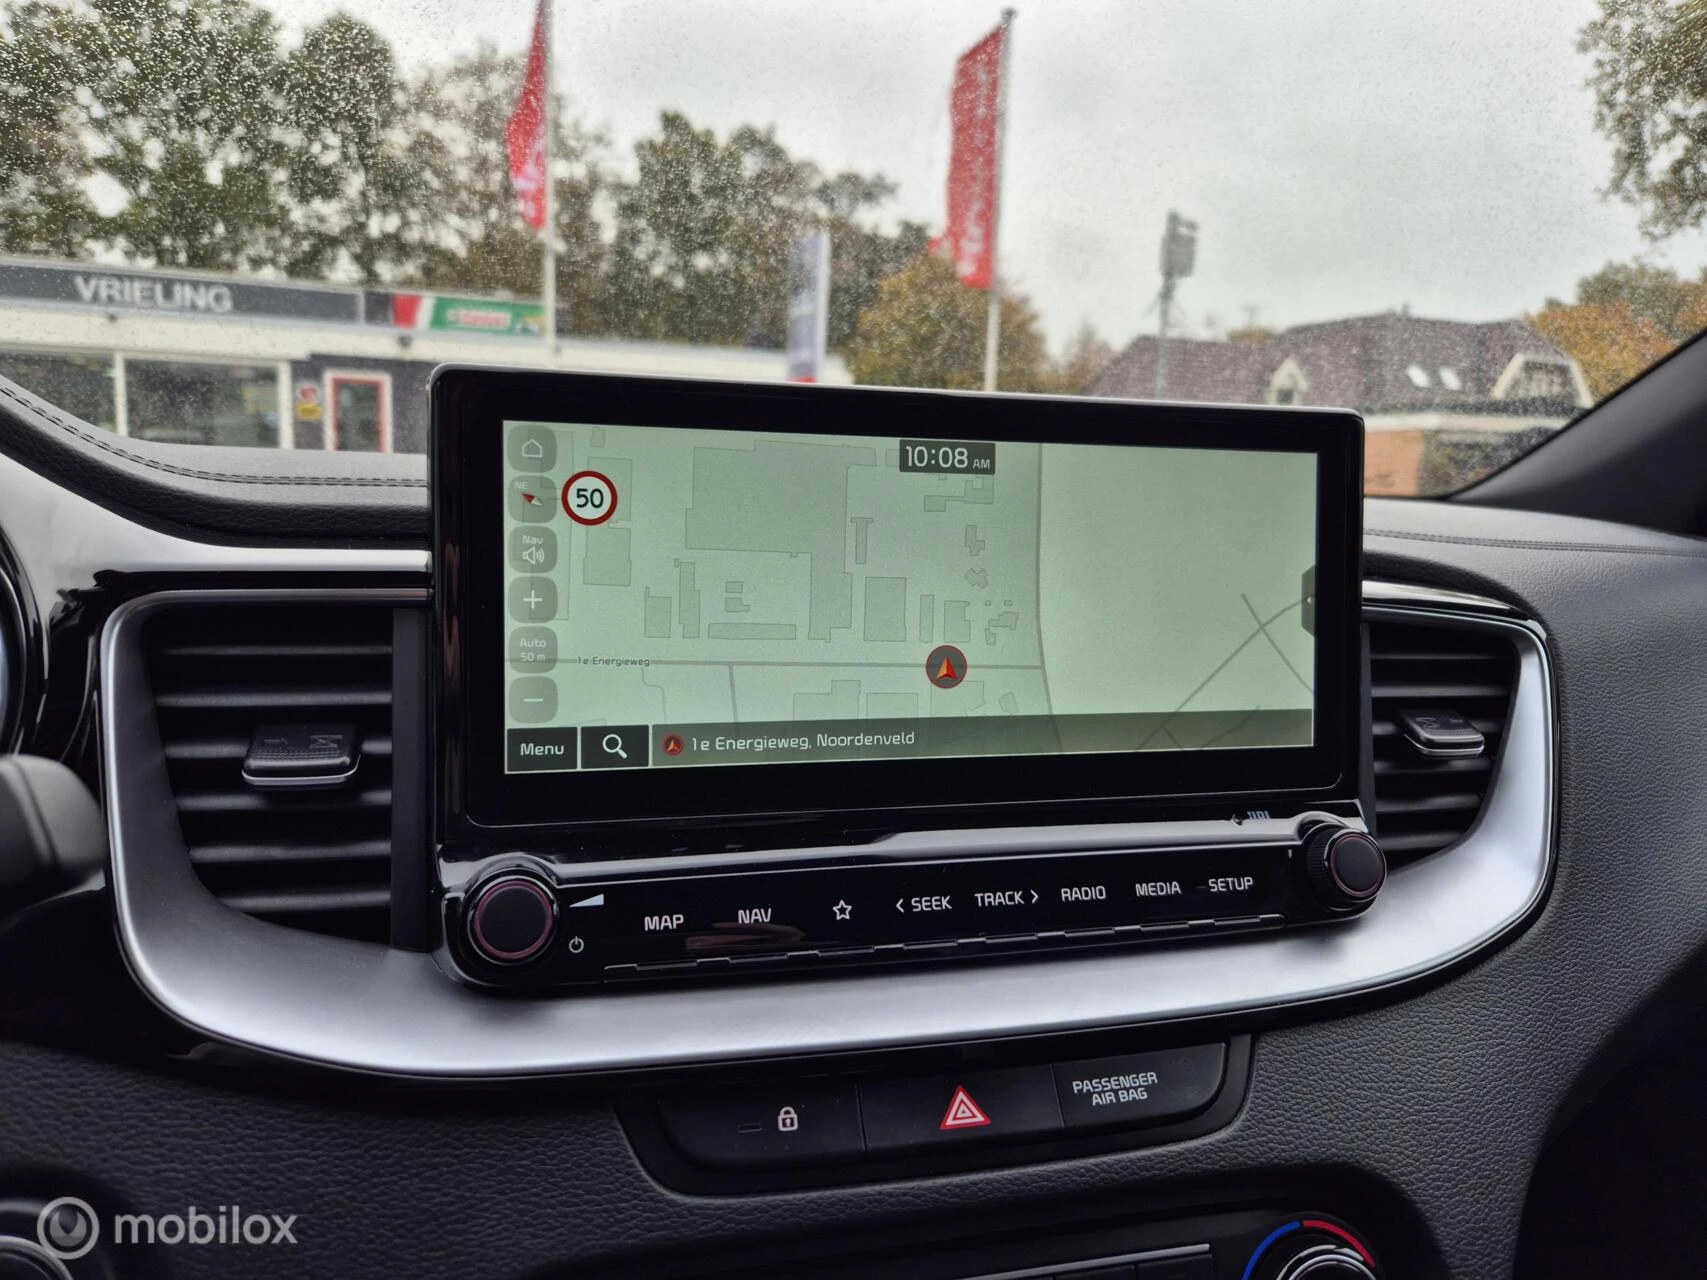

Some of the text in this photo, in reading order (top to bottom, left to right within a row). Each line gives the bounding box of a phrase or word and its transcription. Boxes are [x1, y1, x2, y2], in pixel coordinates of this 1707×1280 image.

[74, 275, 233, 314] VRIELING
[905, 446, 991, 469] 10:08 AM
[575, 488, 604, 509] 50
[522, 535, 544, 545] Nav
[520, 638, 547, 648] Auto
[520, 652, 546, 662] 50 m
[592, 656, 650, 667] Energieweg
[691, 737, 710, 752] 1e
[816, 731, 915, 748] Noordenveld
[520, 743, 565, 757] Menu
[1135, 881, 1182, 897] MEDIA
[1208, 876, 1254, 892] SETUP
[975, 891, 1025, 907] TRACK
[1061, 886, 1107, 901] RADIO
[911, 896, 952, 912] SEEK
[644, 914, 684, 931] MAP
[738, 908, 772, 924] NAV
[1072, 1071, 1159, 1094] PASSENGER
[1092, 1087, 1148, 1106] AIR BAG
